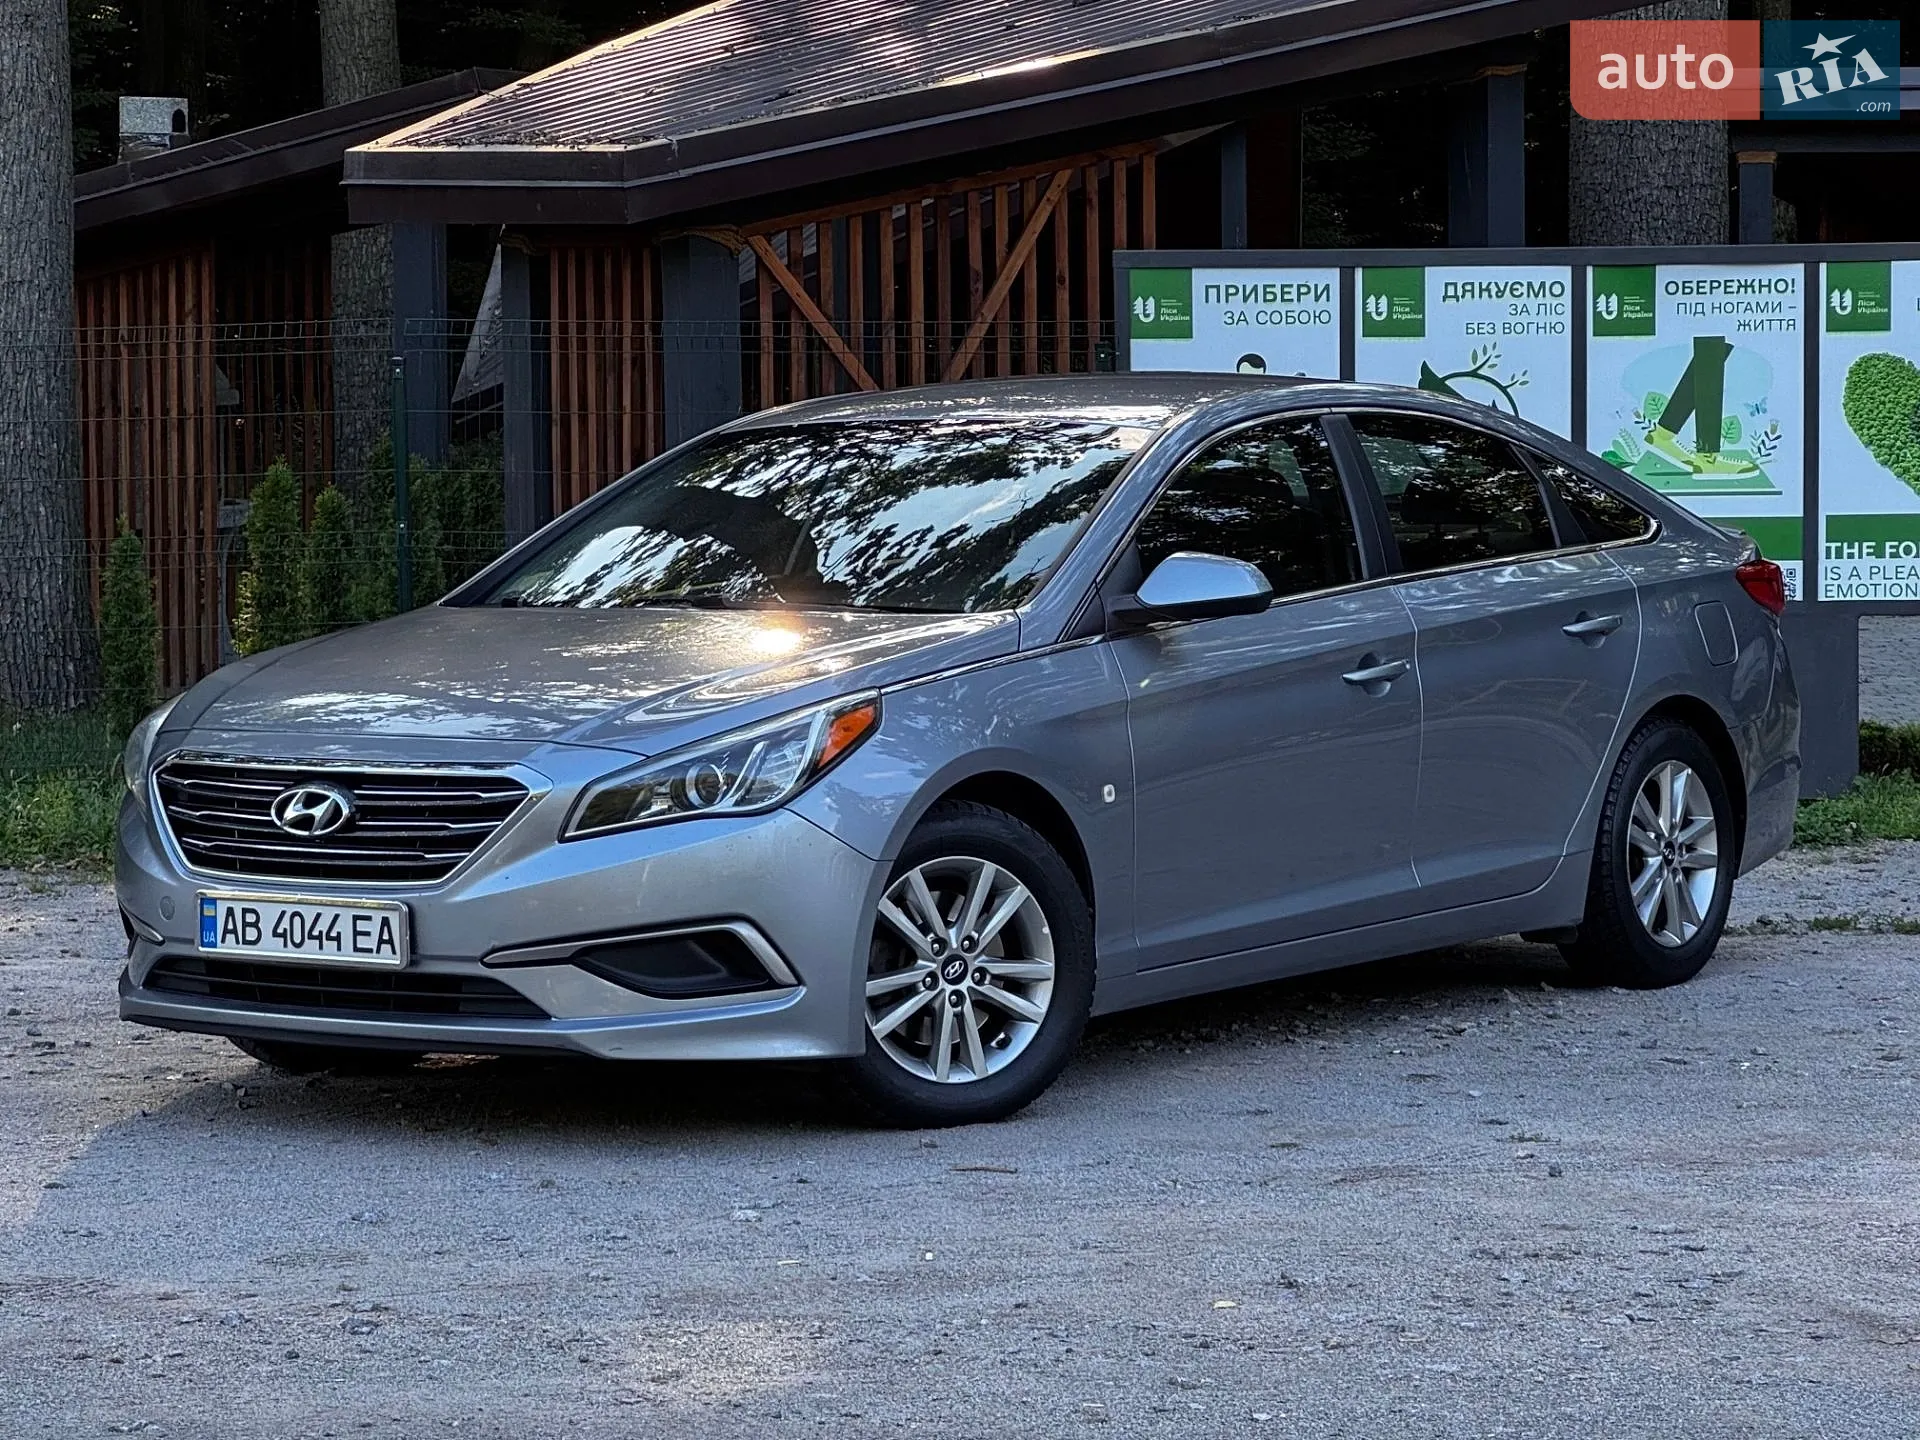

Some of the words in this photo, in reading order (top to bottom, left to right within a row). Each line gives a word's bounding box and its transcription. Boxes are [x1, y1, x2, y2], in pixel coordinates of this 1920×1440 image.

[1204, 283, 1331, 304] ПРИБЕРИ
[1442, 280, 1566, 303] ДЯКУЄМО
[1664, 278, 1796, 296] ОБЕРЕЖНО!
[1508, 303, 1531, 316] ЗА
[1535, 302, 1566, 316] ЛІС
[1676, 301, 1706, 317] ПІД
[1711, 300, 1782, 315] НОГАМИ
[1223, 310, 1249, 326] ЗА
[1255, 309, 1332, 326] СОБОЮ
[1737, 318, 1796, 332] ЖИТТЯ
[1465, 322, 1496, 336] БЕЗ
[1502, 321, 1566, 335] ВОГНЮ
[1825, 541, 1876, 560] THE
[1885, 541, 1920, 559] FO
[1824, 565, 1842, 581] IS
[1848, 565, 1862, 581] A
[1824, 582, 1918, 599] EMOTION
[203, 930, 216, 944] UA
[220, 906, 263, 946] AB
[271, 909, 343, 952] 4044
[352, 914, 397, 955] EA
